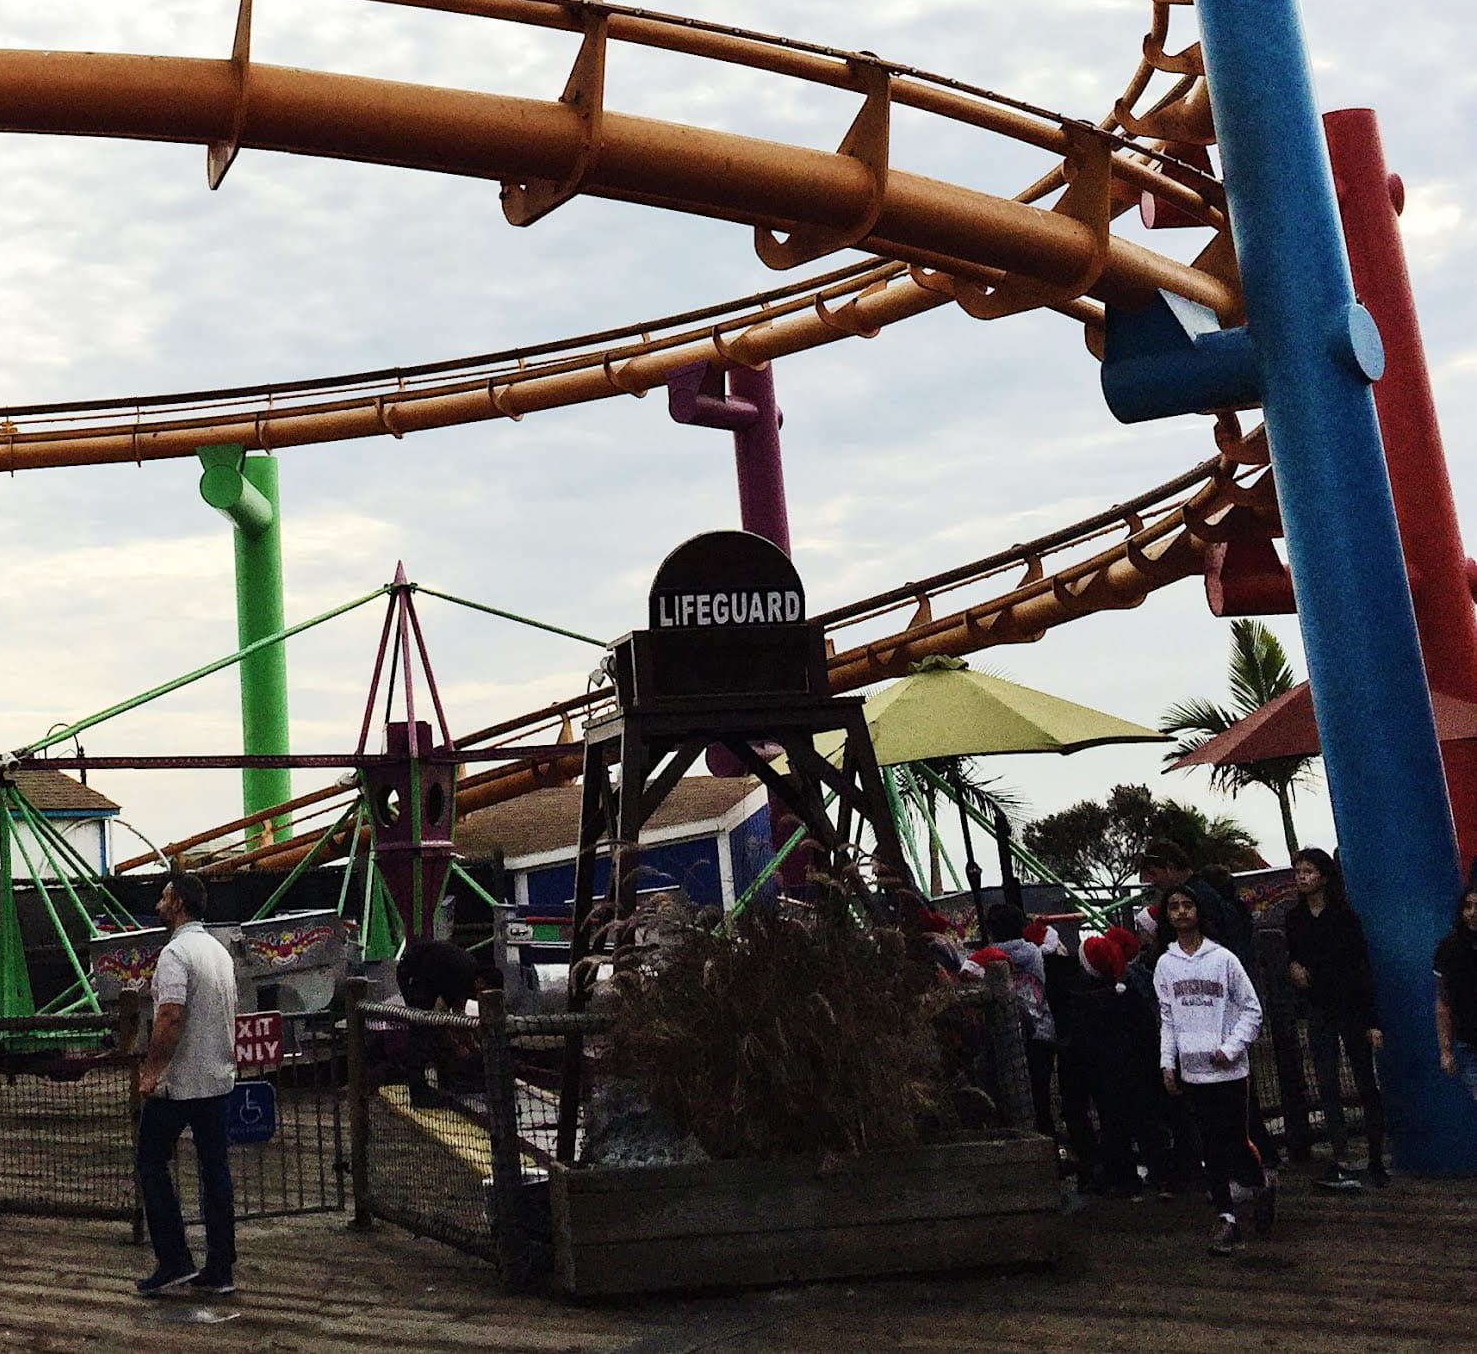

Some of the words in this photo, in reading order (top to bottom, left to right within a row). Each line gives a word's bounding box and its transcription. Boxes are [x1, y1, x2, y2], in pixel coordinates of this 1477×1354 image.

[658, 590, 801, 628] LIFEGUARD
[236, 1017, 274, 1039] XIT
[235, 1041, 279, 1063] NLY
